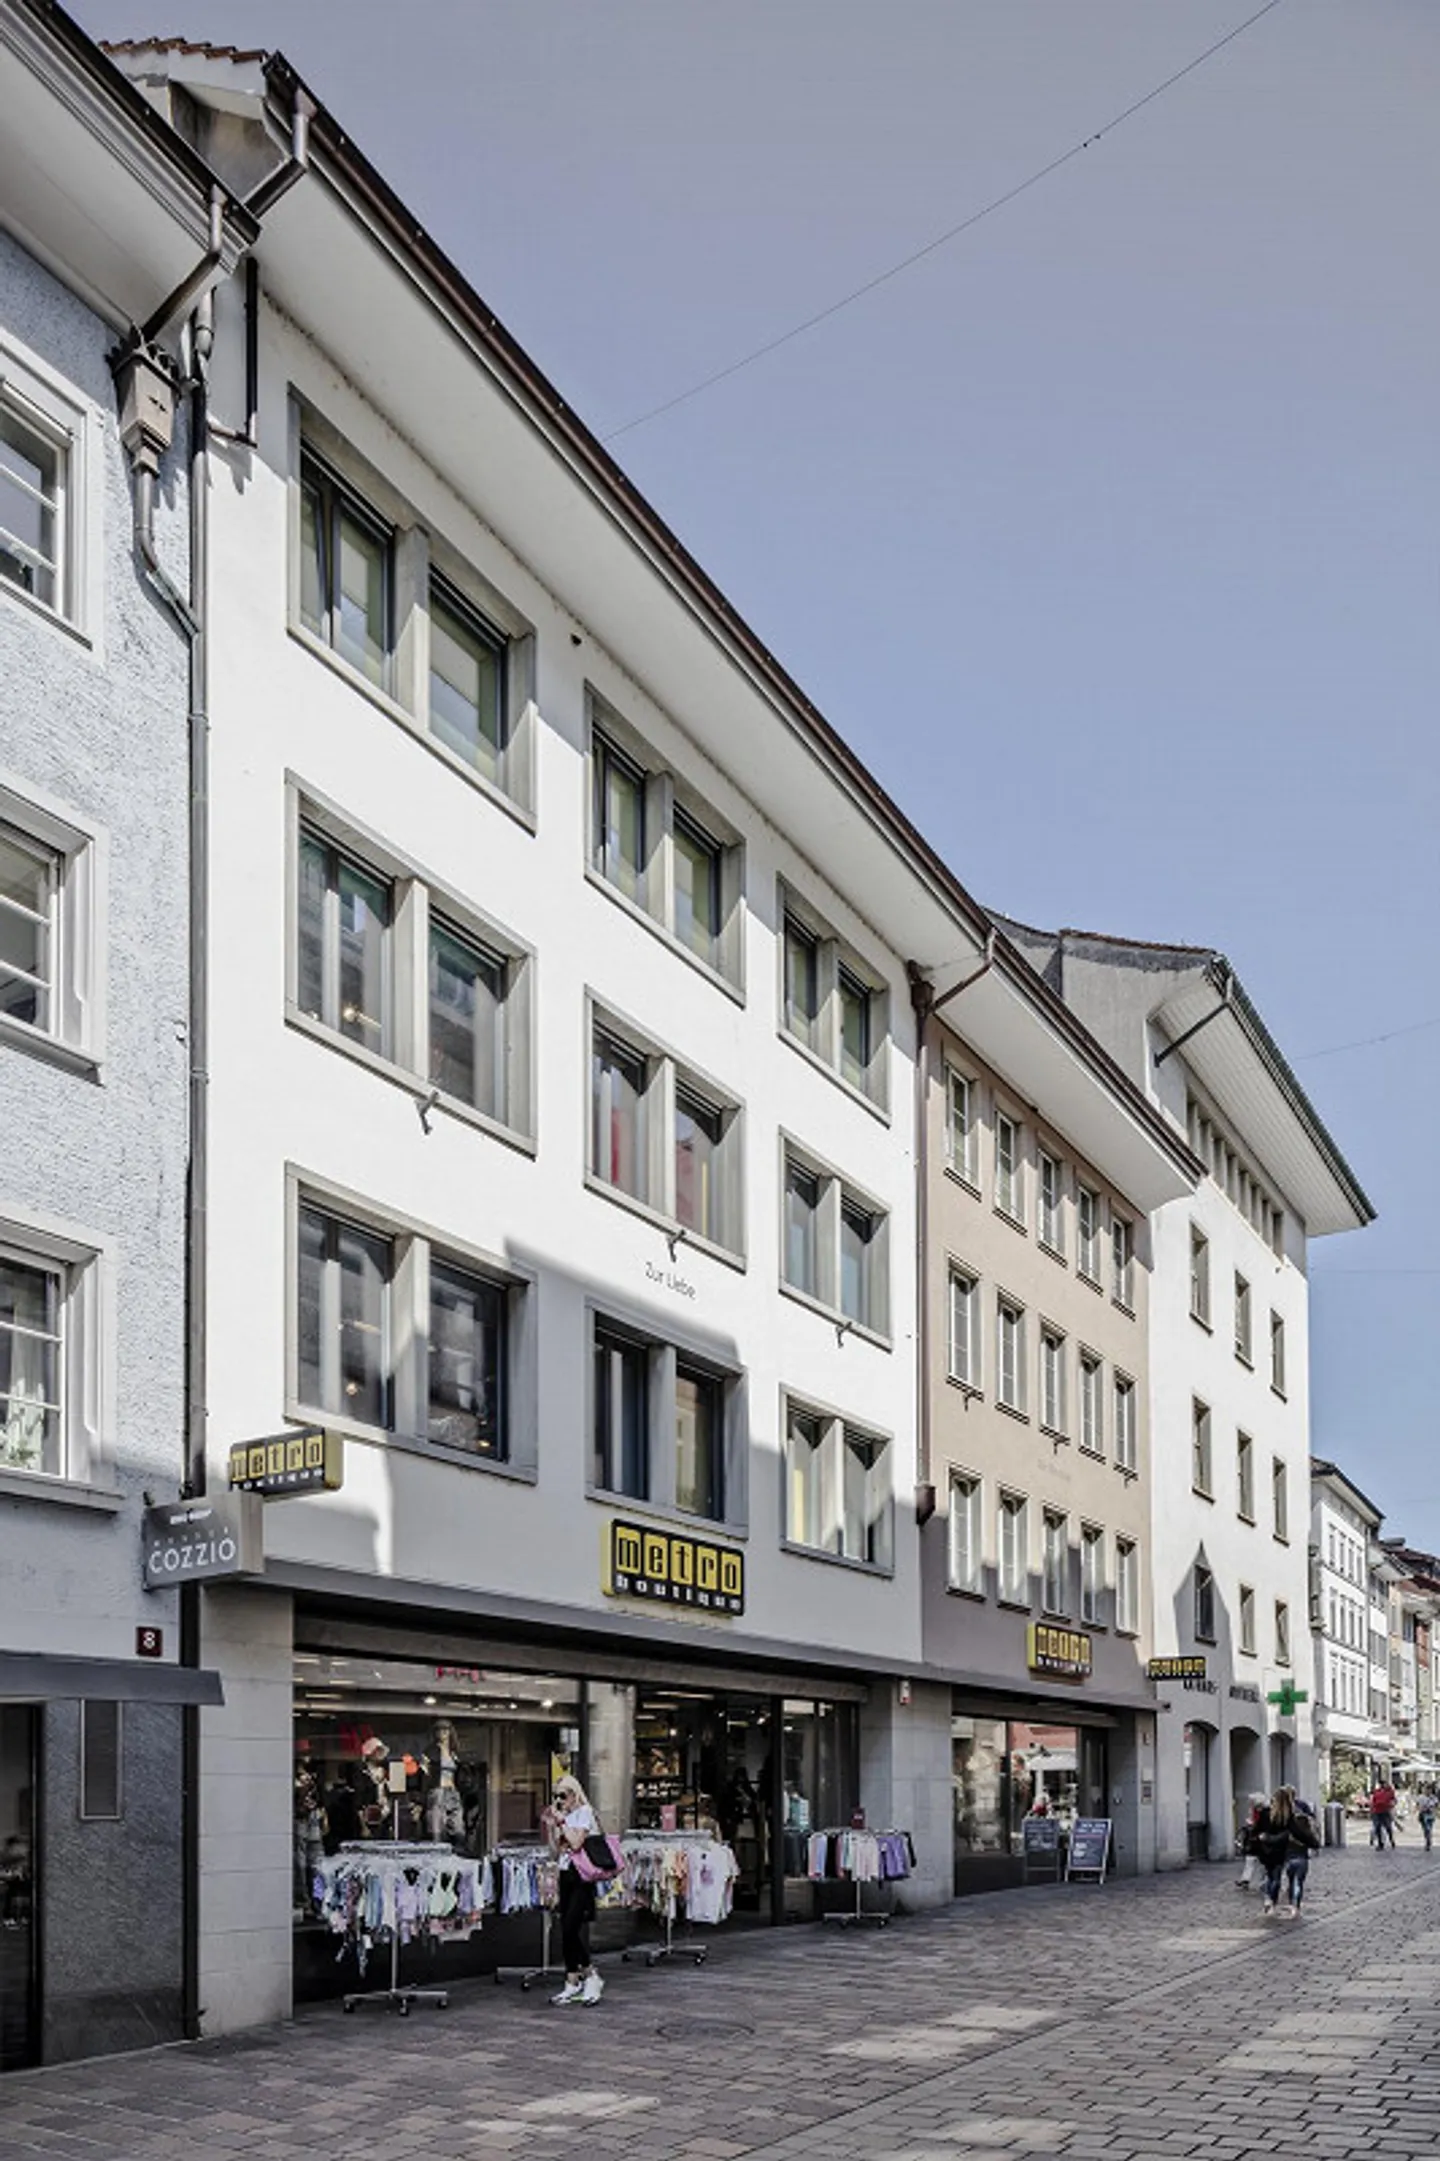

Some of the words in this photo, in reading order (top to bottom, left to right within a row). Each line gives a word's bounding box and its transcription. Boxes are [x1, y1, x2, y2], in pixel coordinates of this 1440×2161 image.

[645, 1261, 663, 1285] Zur
[149, 1537, 236, 1574] COZZIO
[617, 1535, 739, 1591] metro
[143, 1631, 155, 1649] 8
